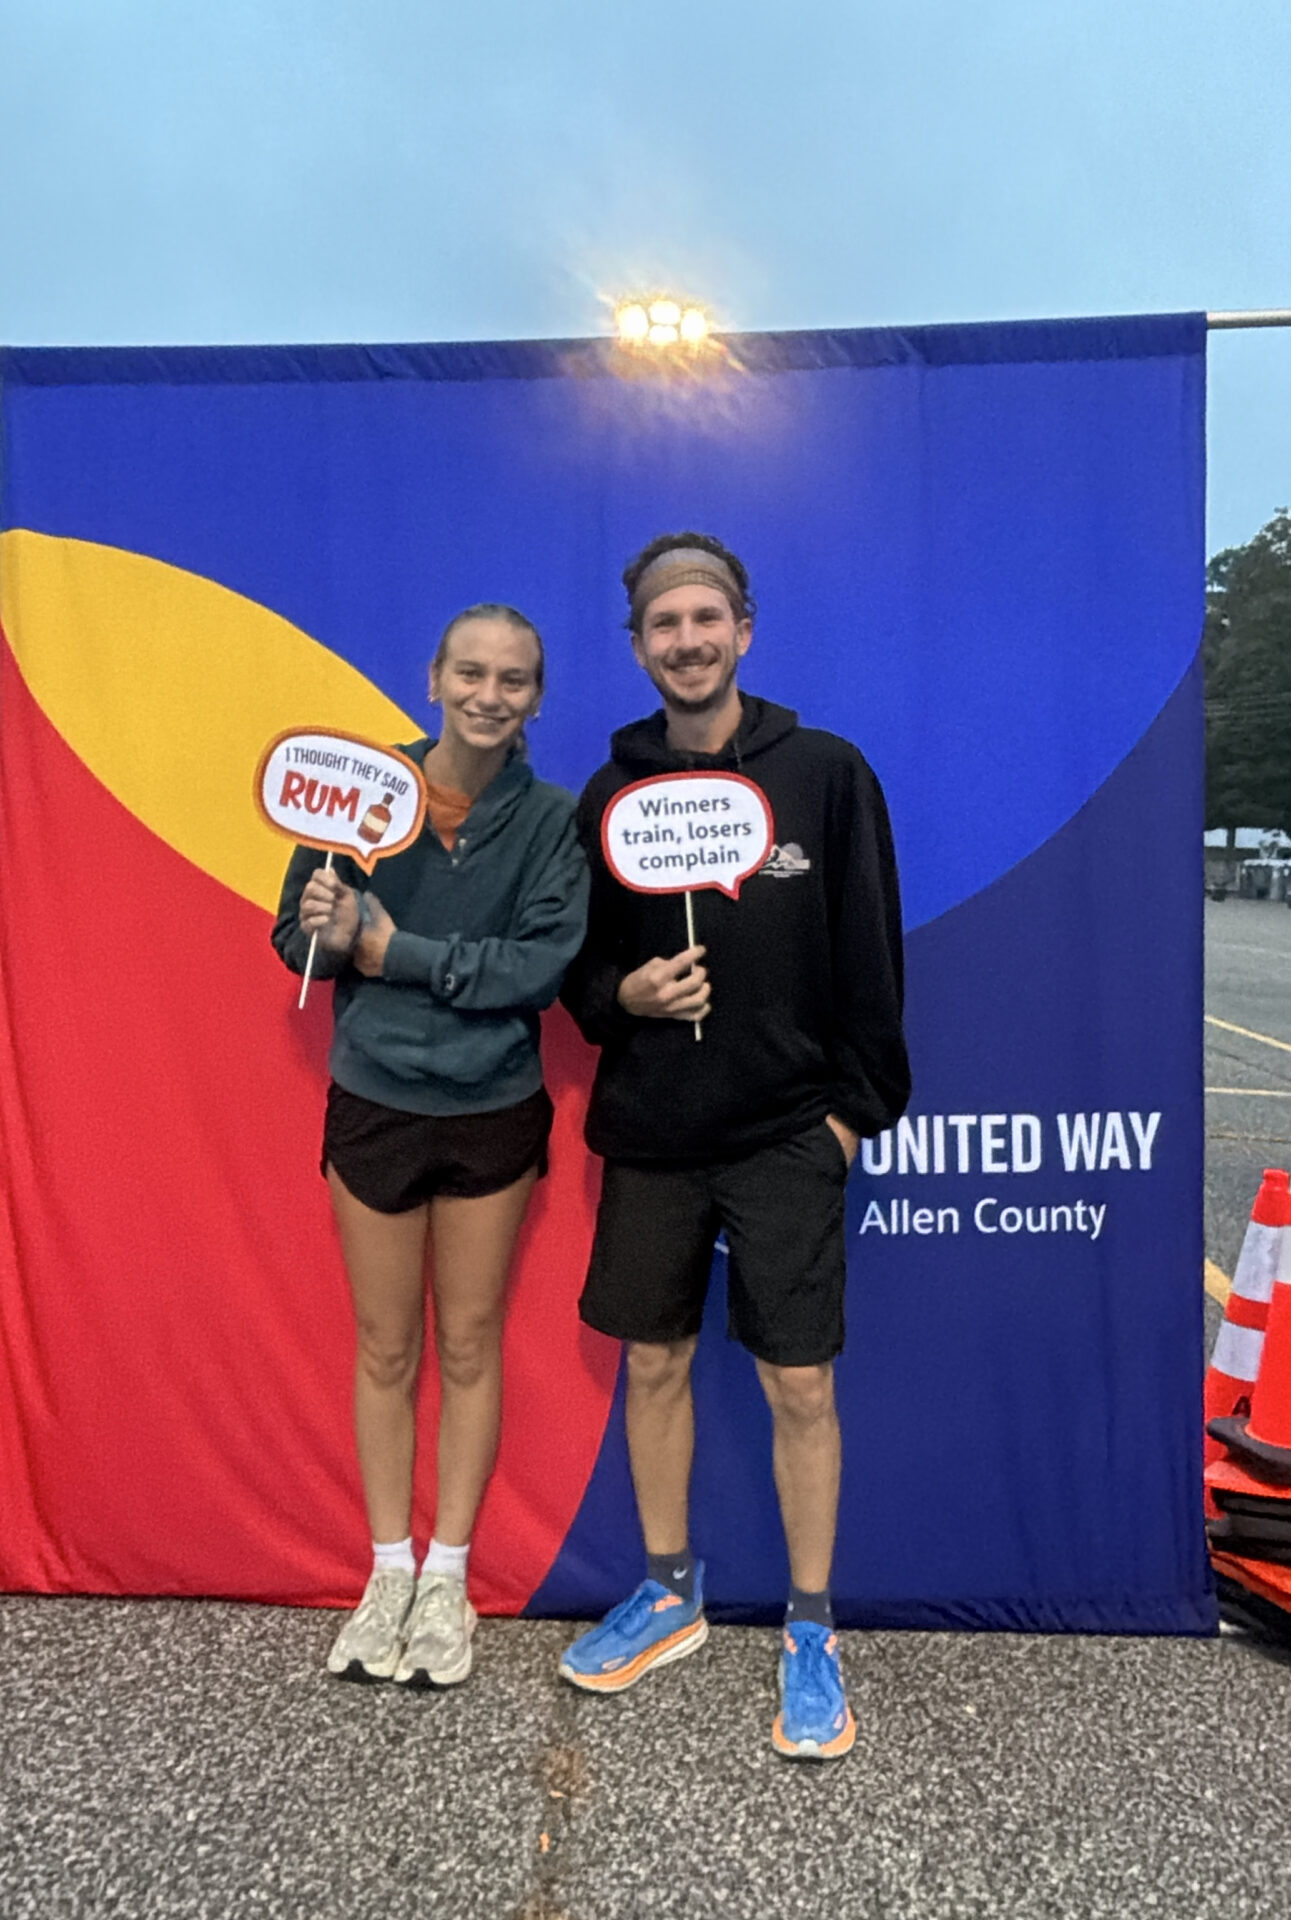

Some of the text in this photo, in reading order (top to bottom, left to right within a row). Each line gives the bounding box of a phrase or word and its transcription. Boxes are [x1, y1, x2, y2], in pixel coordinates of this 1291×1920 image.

[285, 747, 409, 796] I THOUGHT THEY SAID
[279, 770, 361, 822] RUM
[639, 797, 731, 817] Winners
[622, 822, 752, 845] train, losers
[639, 846, 740, 870] complain
[861, 1111, 1162, 1175] UNITED WAY
[859, 1198, 1106, 1240] Allen County
